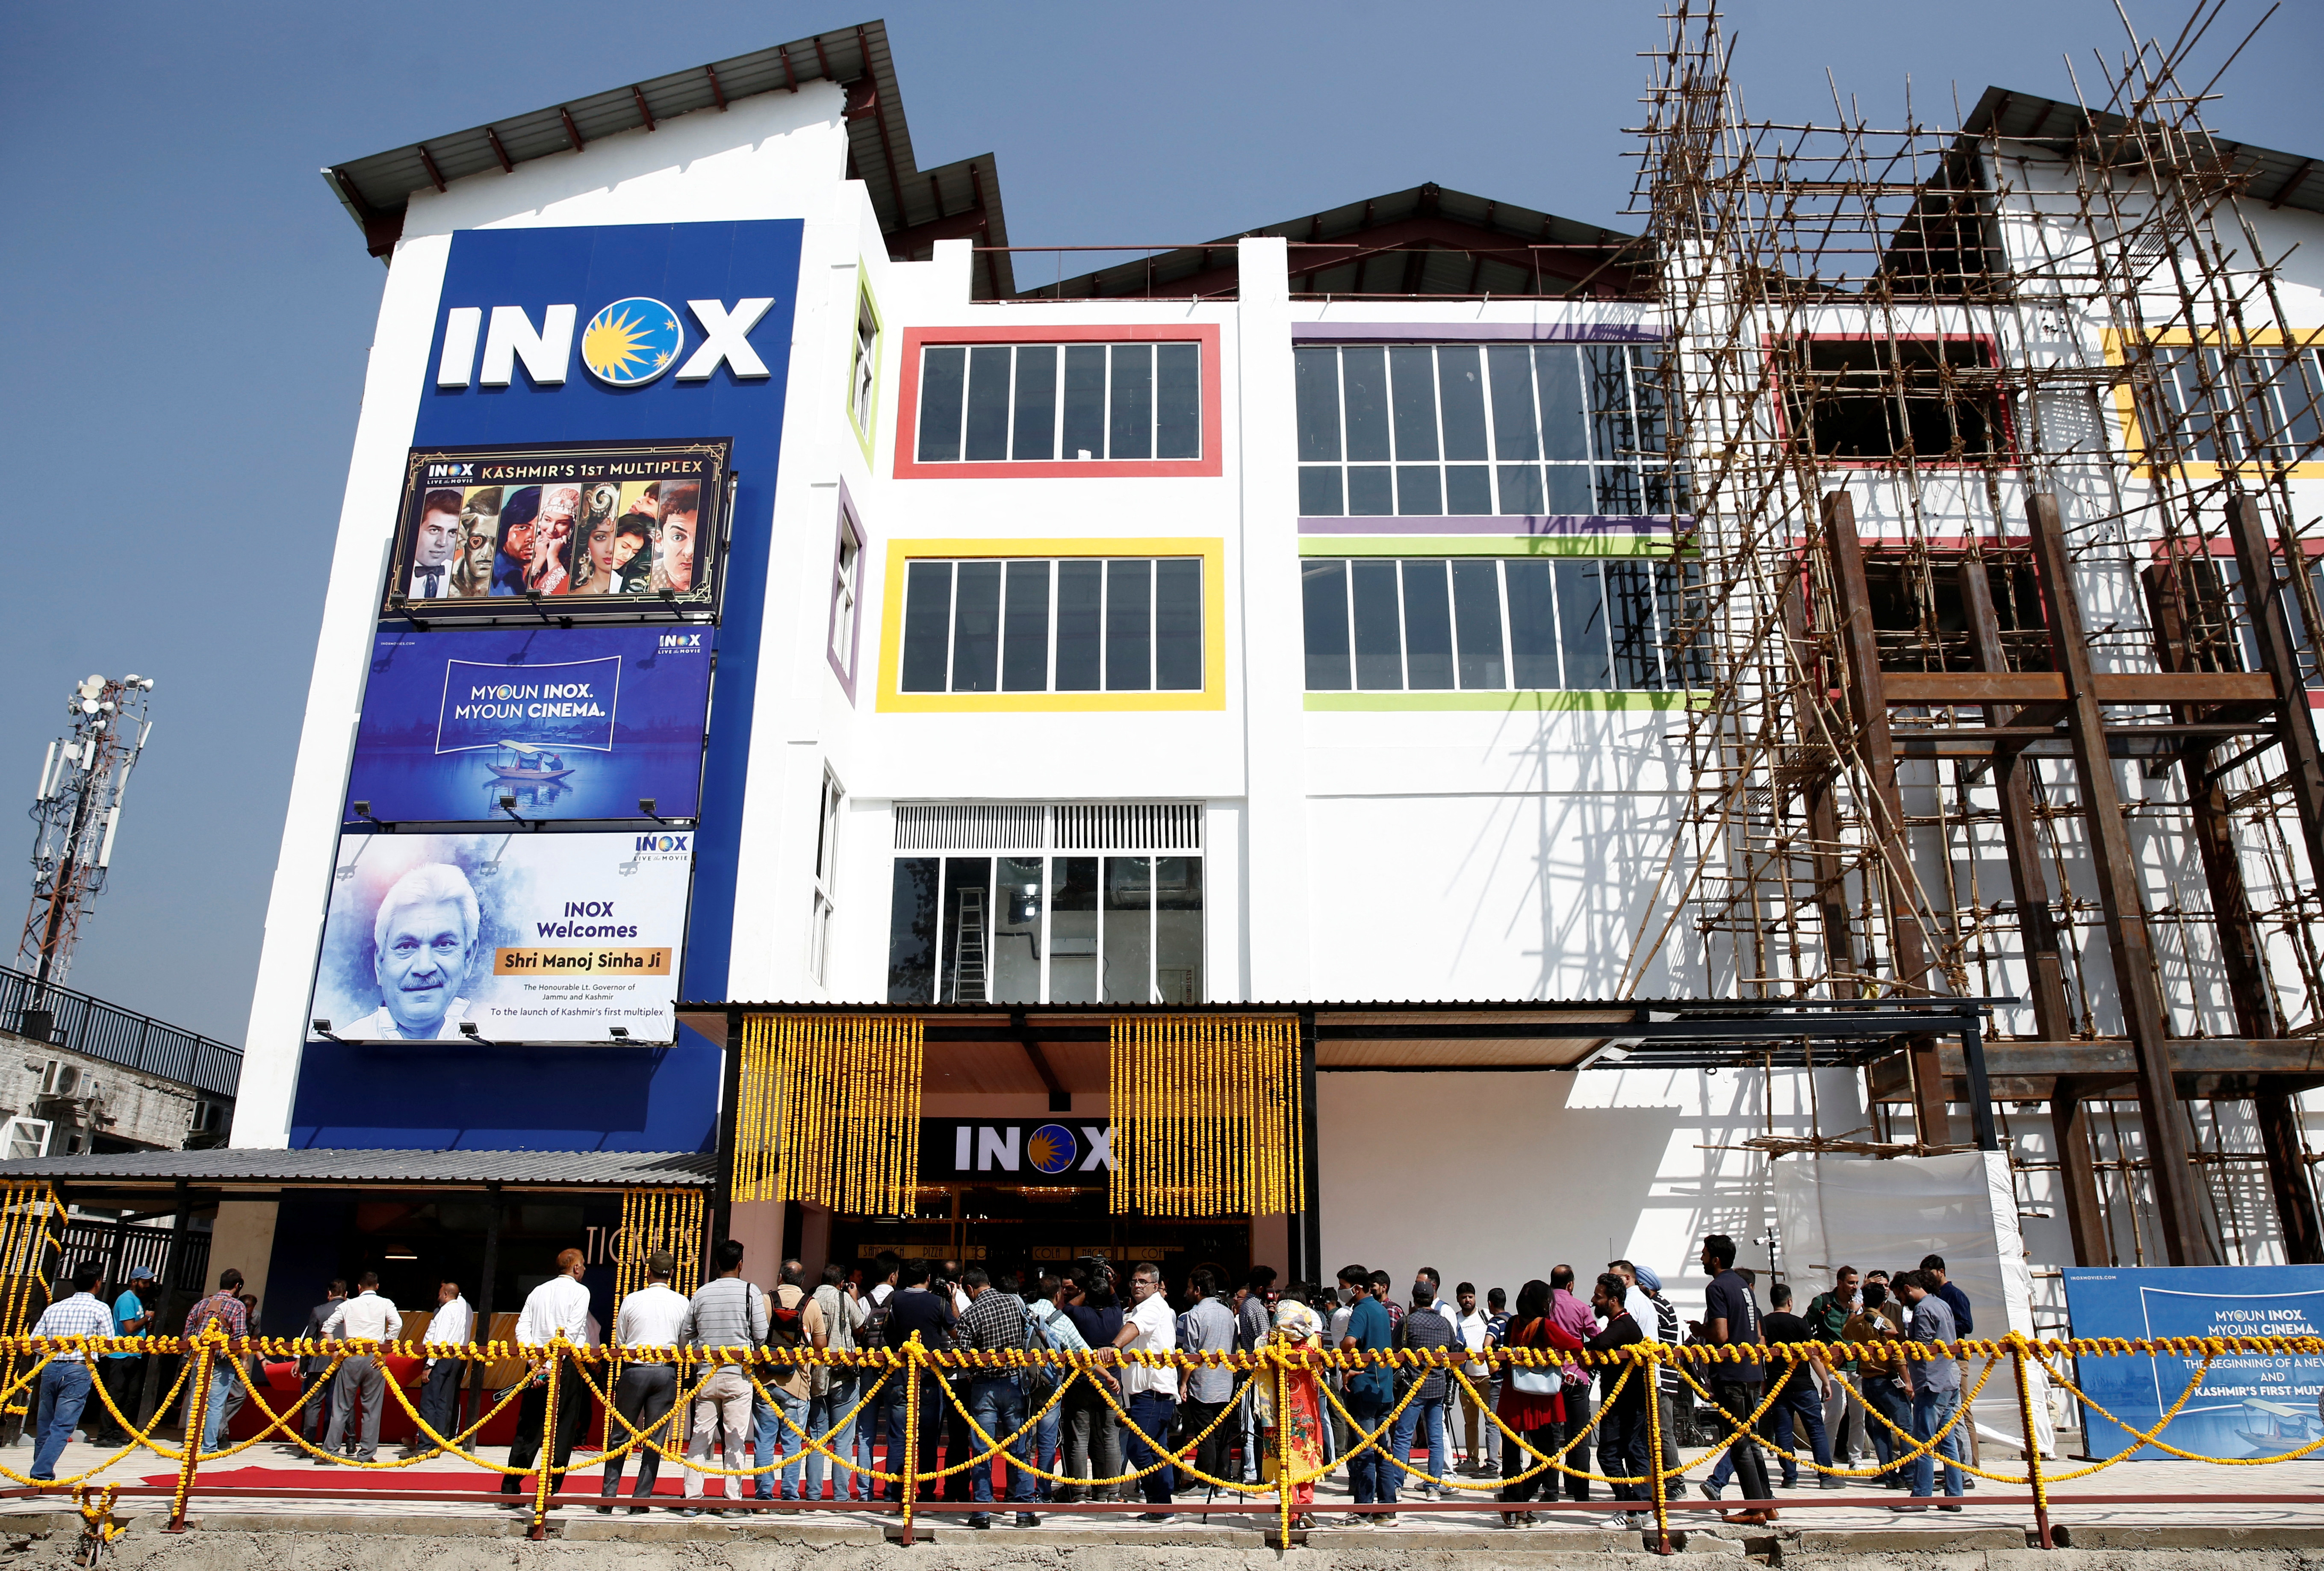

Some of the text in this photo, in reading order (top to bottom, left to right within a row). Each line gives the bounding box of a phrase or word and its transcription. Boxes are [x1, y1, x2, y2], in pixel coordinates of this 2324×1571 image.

[437, 297, 776, 387] INOX
[428, 463, 475, 477] INOX
[482, 465, 575, 479] KASHMIR'S
[610, 461, 702, 475] MULTIPLEX
[659, 634, 701, 647] INOX
[471, 684, 594, 700] MYOUN INOX.
[455, 702, 606, 719] MYOUN CINEMA.
[636, 836, 688, 852] INOX
[564, 902, 614, 917] INOX
[537, 920, 638, 938] Welcomes
[505, 952, 661, 971] Shri Manoj Sinha Ji
[550, 1008, 561, 1016] of
[561, 1008, 602, 1016] Kashmir's
[604, 1008, 621, 1016] first
[623, 1008, 664, 1017] multiplex
[955, 1124, 1124, 1174] INOX
[586, 1226, 696, 1265] TICKETS
[923, 1247, 944, 1258] PIZZA
[1035, 1248, 1060, 1259] COLA
[1082, 1248, 1112, 1259] NACHO
[2215, 1310, 2306, 1322] MYOUN INOX.
[2208, 1323, 2319, 1335] MYOUN CINEMA.
[2209, 1359, 2272, 1369] BEGINNING
[2275, 1358, 2291, 1368] OF
[2294, 1358, 2303, 1368] A
[2260, 1372, 2285, 1382] AND
[2194, 1386, 2257, 1397] KASHMIR'S
[2260, 1386, 2292, 1396] FIRST
